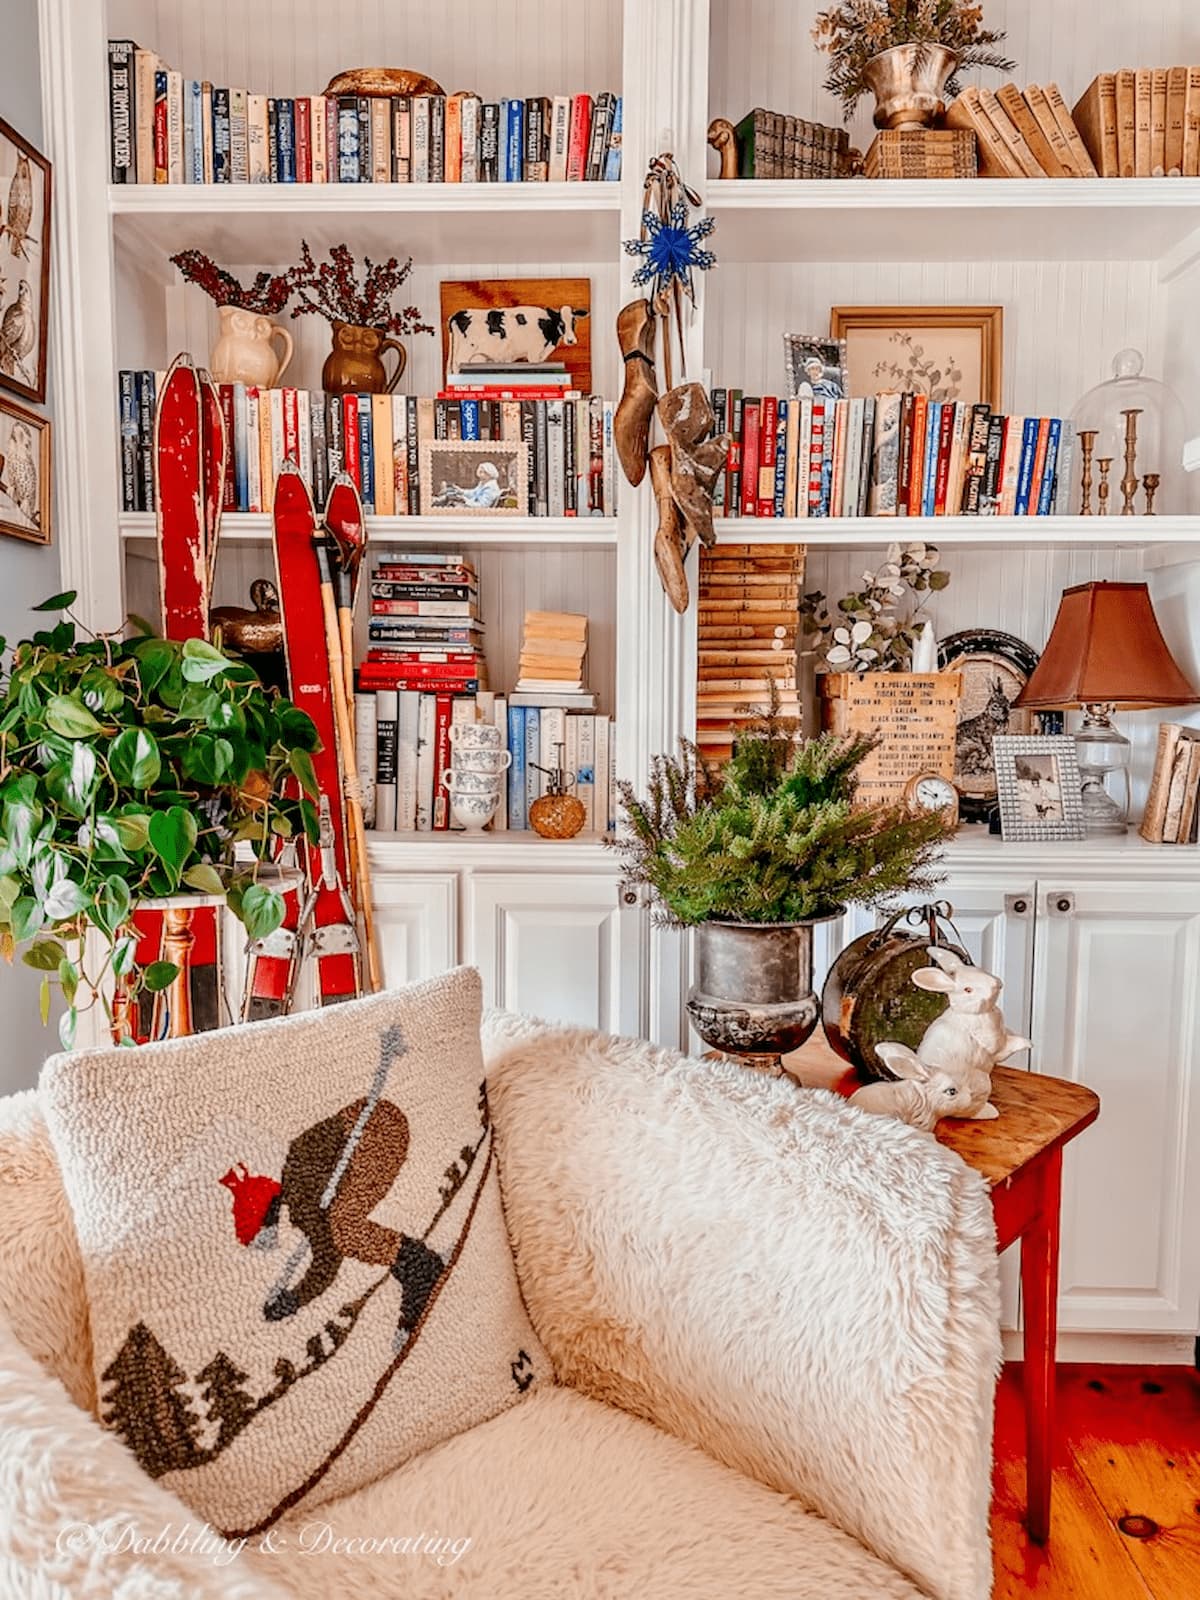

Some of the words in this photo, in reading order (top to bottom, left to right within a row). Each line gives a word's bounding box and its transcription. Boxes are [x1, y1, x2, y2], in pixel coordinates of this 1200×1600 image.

[113, 68, 127, 89] THE
[113, 90, 130, 167] TOMMYKNOCKERS
[232, 116, 245, 137] JOHN
[232, 140, 247, 181] GRISHAM
[122, 375, 132, 394] JOHN
[361, 416, 369, 441] HEART
[363, 443, 368, 453] OF
[409, 436, 415, 447] TO
[124, 444, 133, 473] CAMINO
[125, 475, 133, 501] ISLAND
